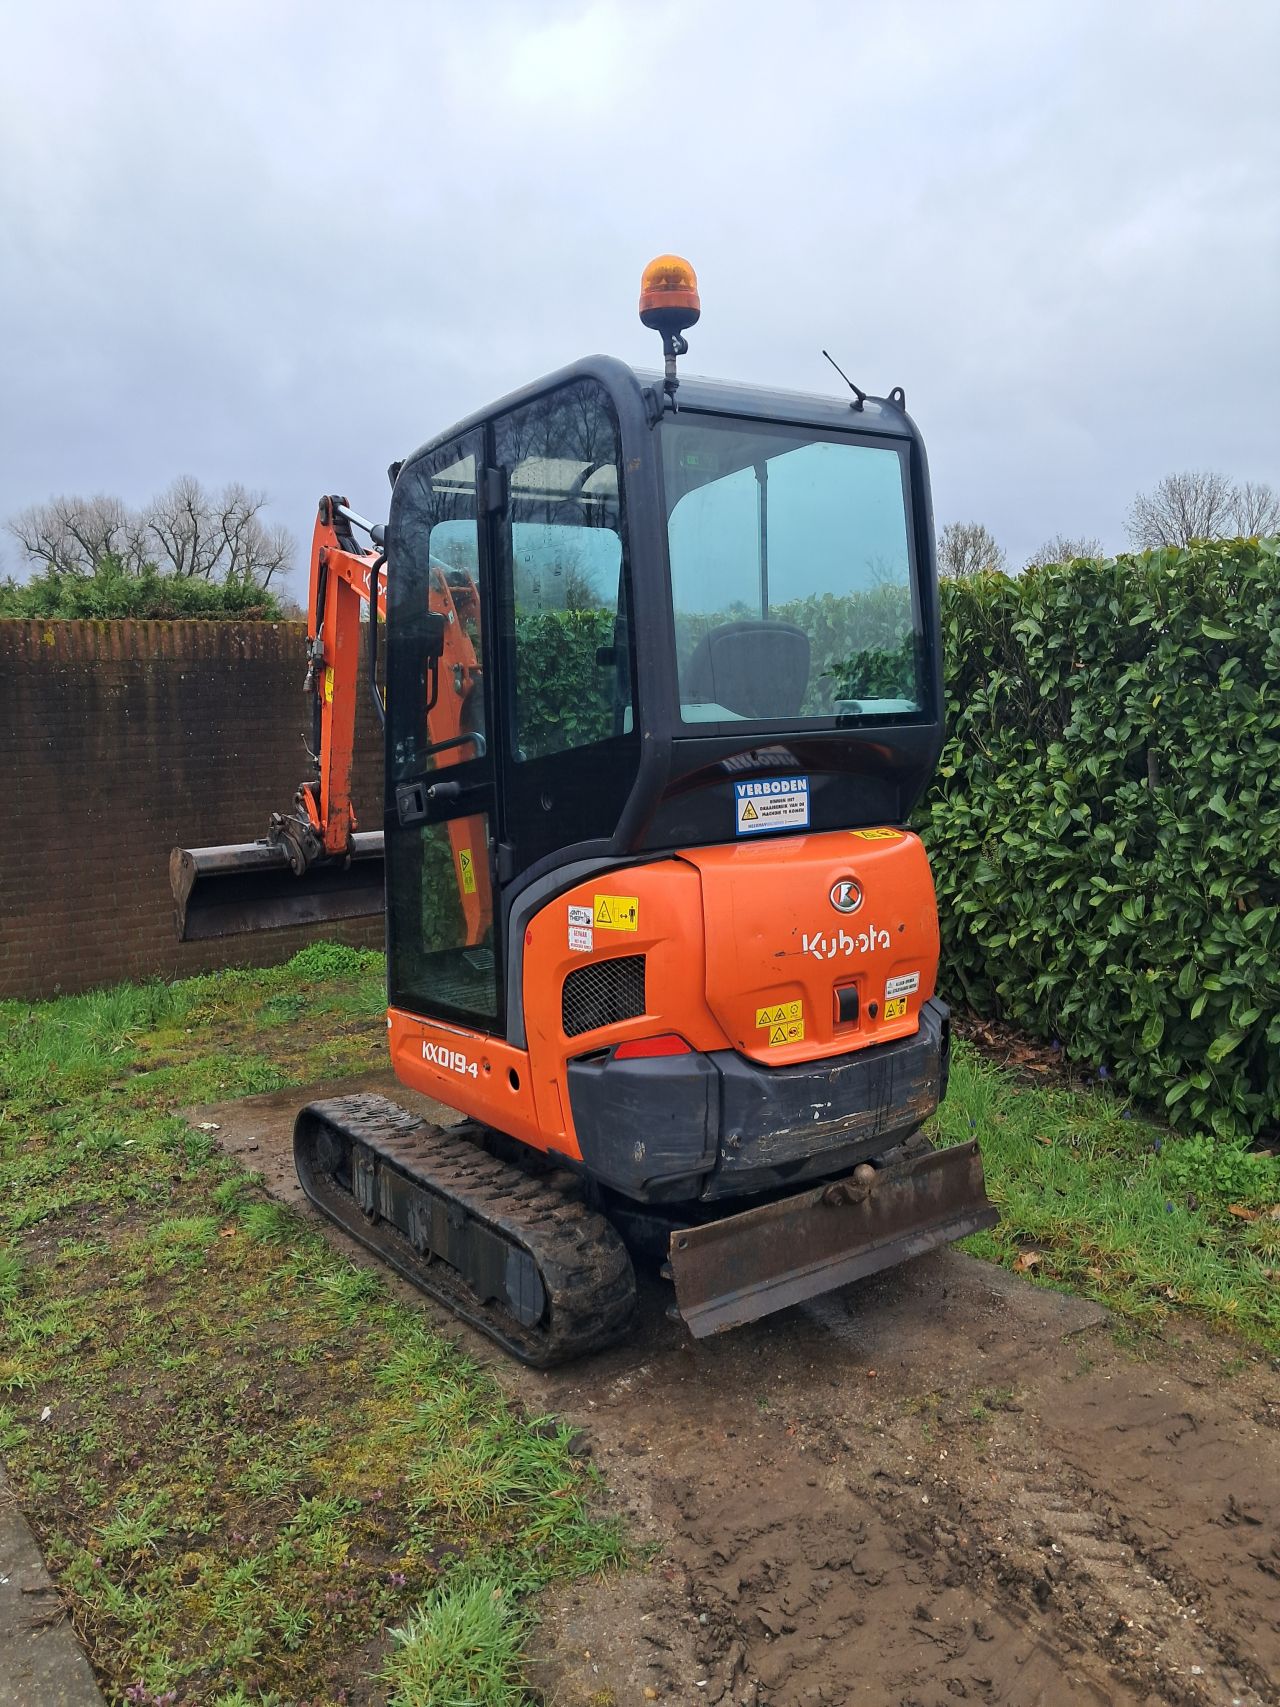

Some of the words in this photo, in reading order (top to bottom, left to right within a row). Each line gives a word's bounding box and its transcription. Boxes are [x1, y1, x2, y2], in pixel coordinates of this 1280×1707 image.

[737, 779, 807, 797] VERBODEN
[802, 924, 891, 960] Kubota
[422, 1040, 479, 1079] KX019-4
